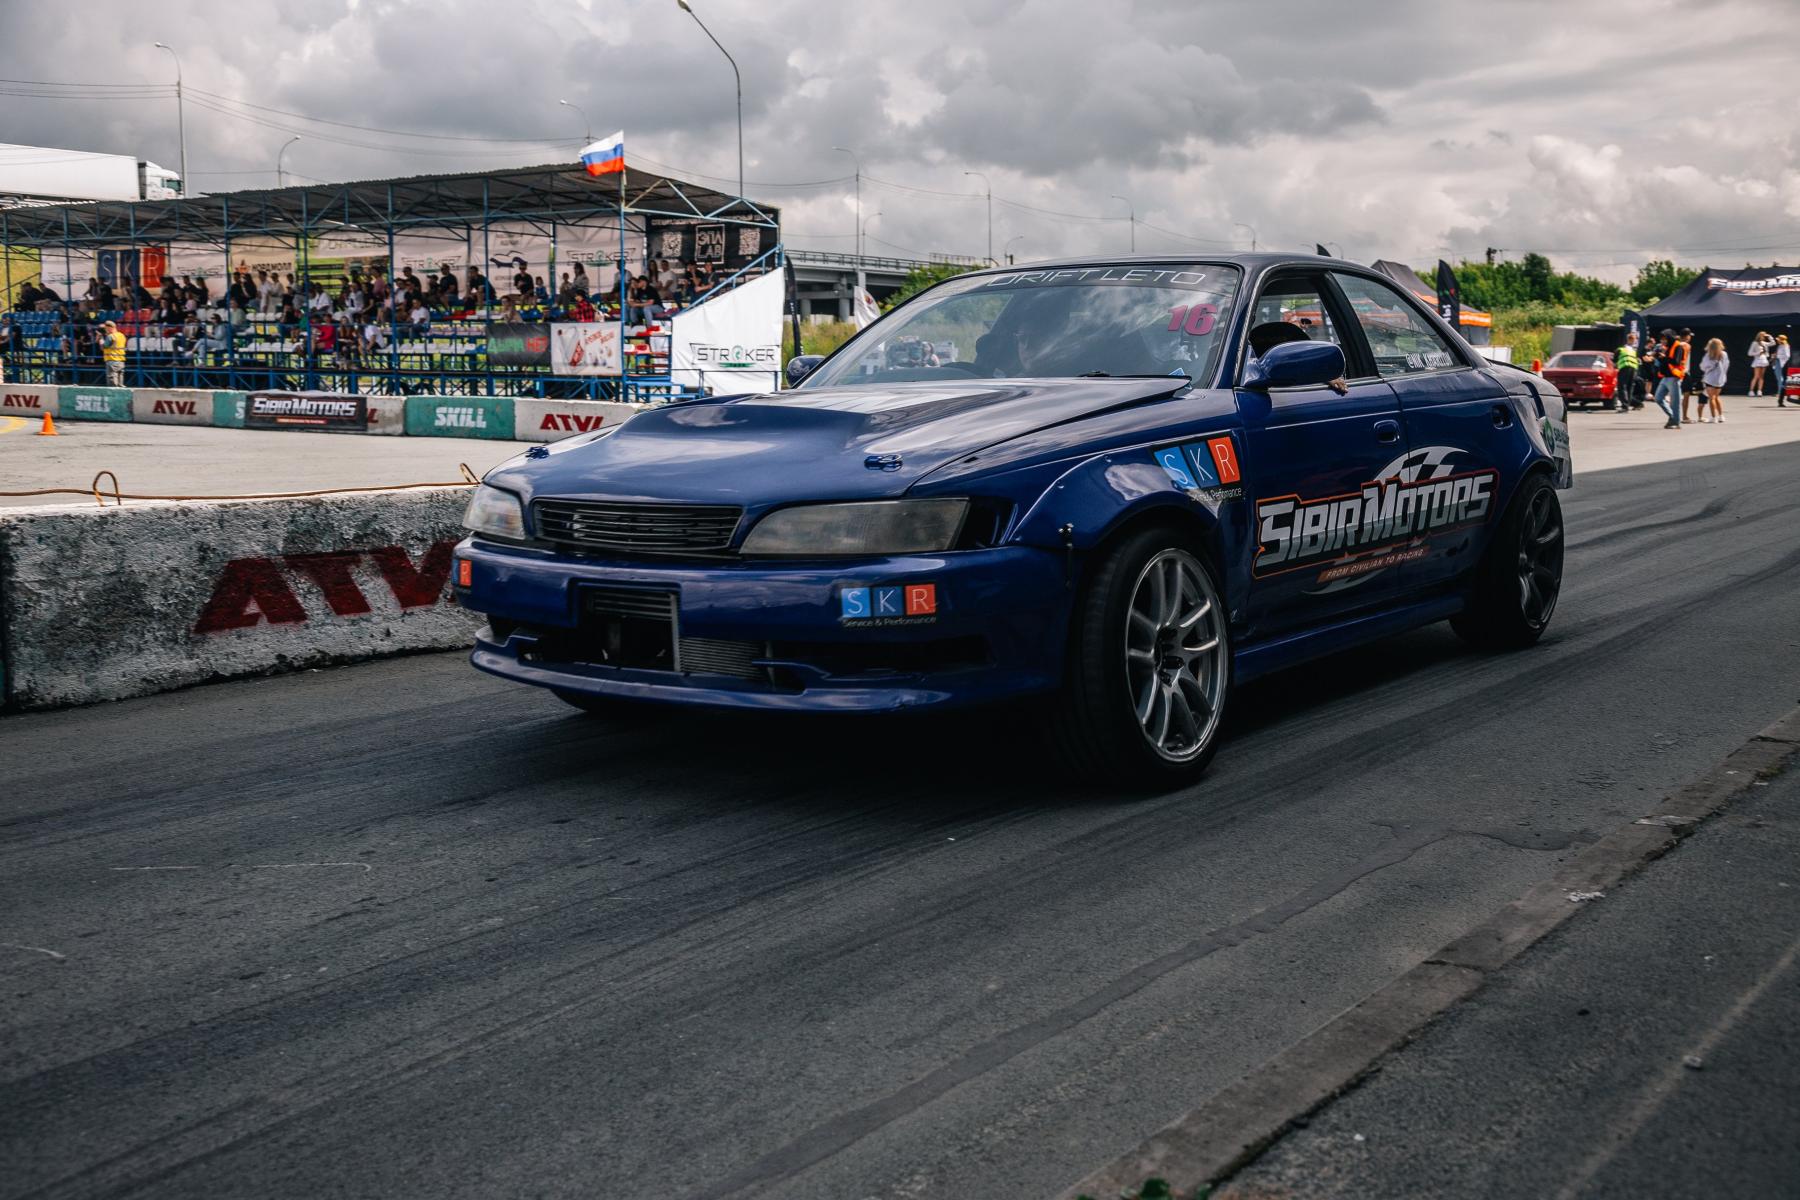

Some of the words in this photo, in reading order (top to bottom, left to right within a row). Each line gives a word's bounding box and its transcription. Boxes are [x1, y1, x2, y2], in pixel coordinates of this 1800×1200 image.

[102, 253, 161, 286] SKR
[1167, 303, 1217, 336] 16
[152, 399, 197, 415] ATVL
[434, 406, 487, 428] SKILL
[1164, 444, 1235, 485] SKR
[1385, 556, 1395, 564] TO
[847, 588, 929, 614] SKR
